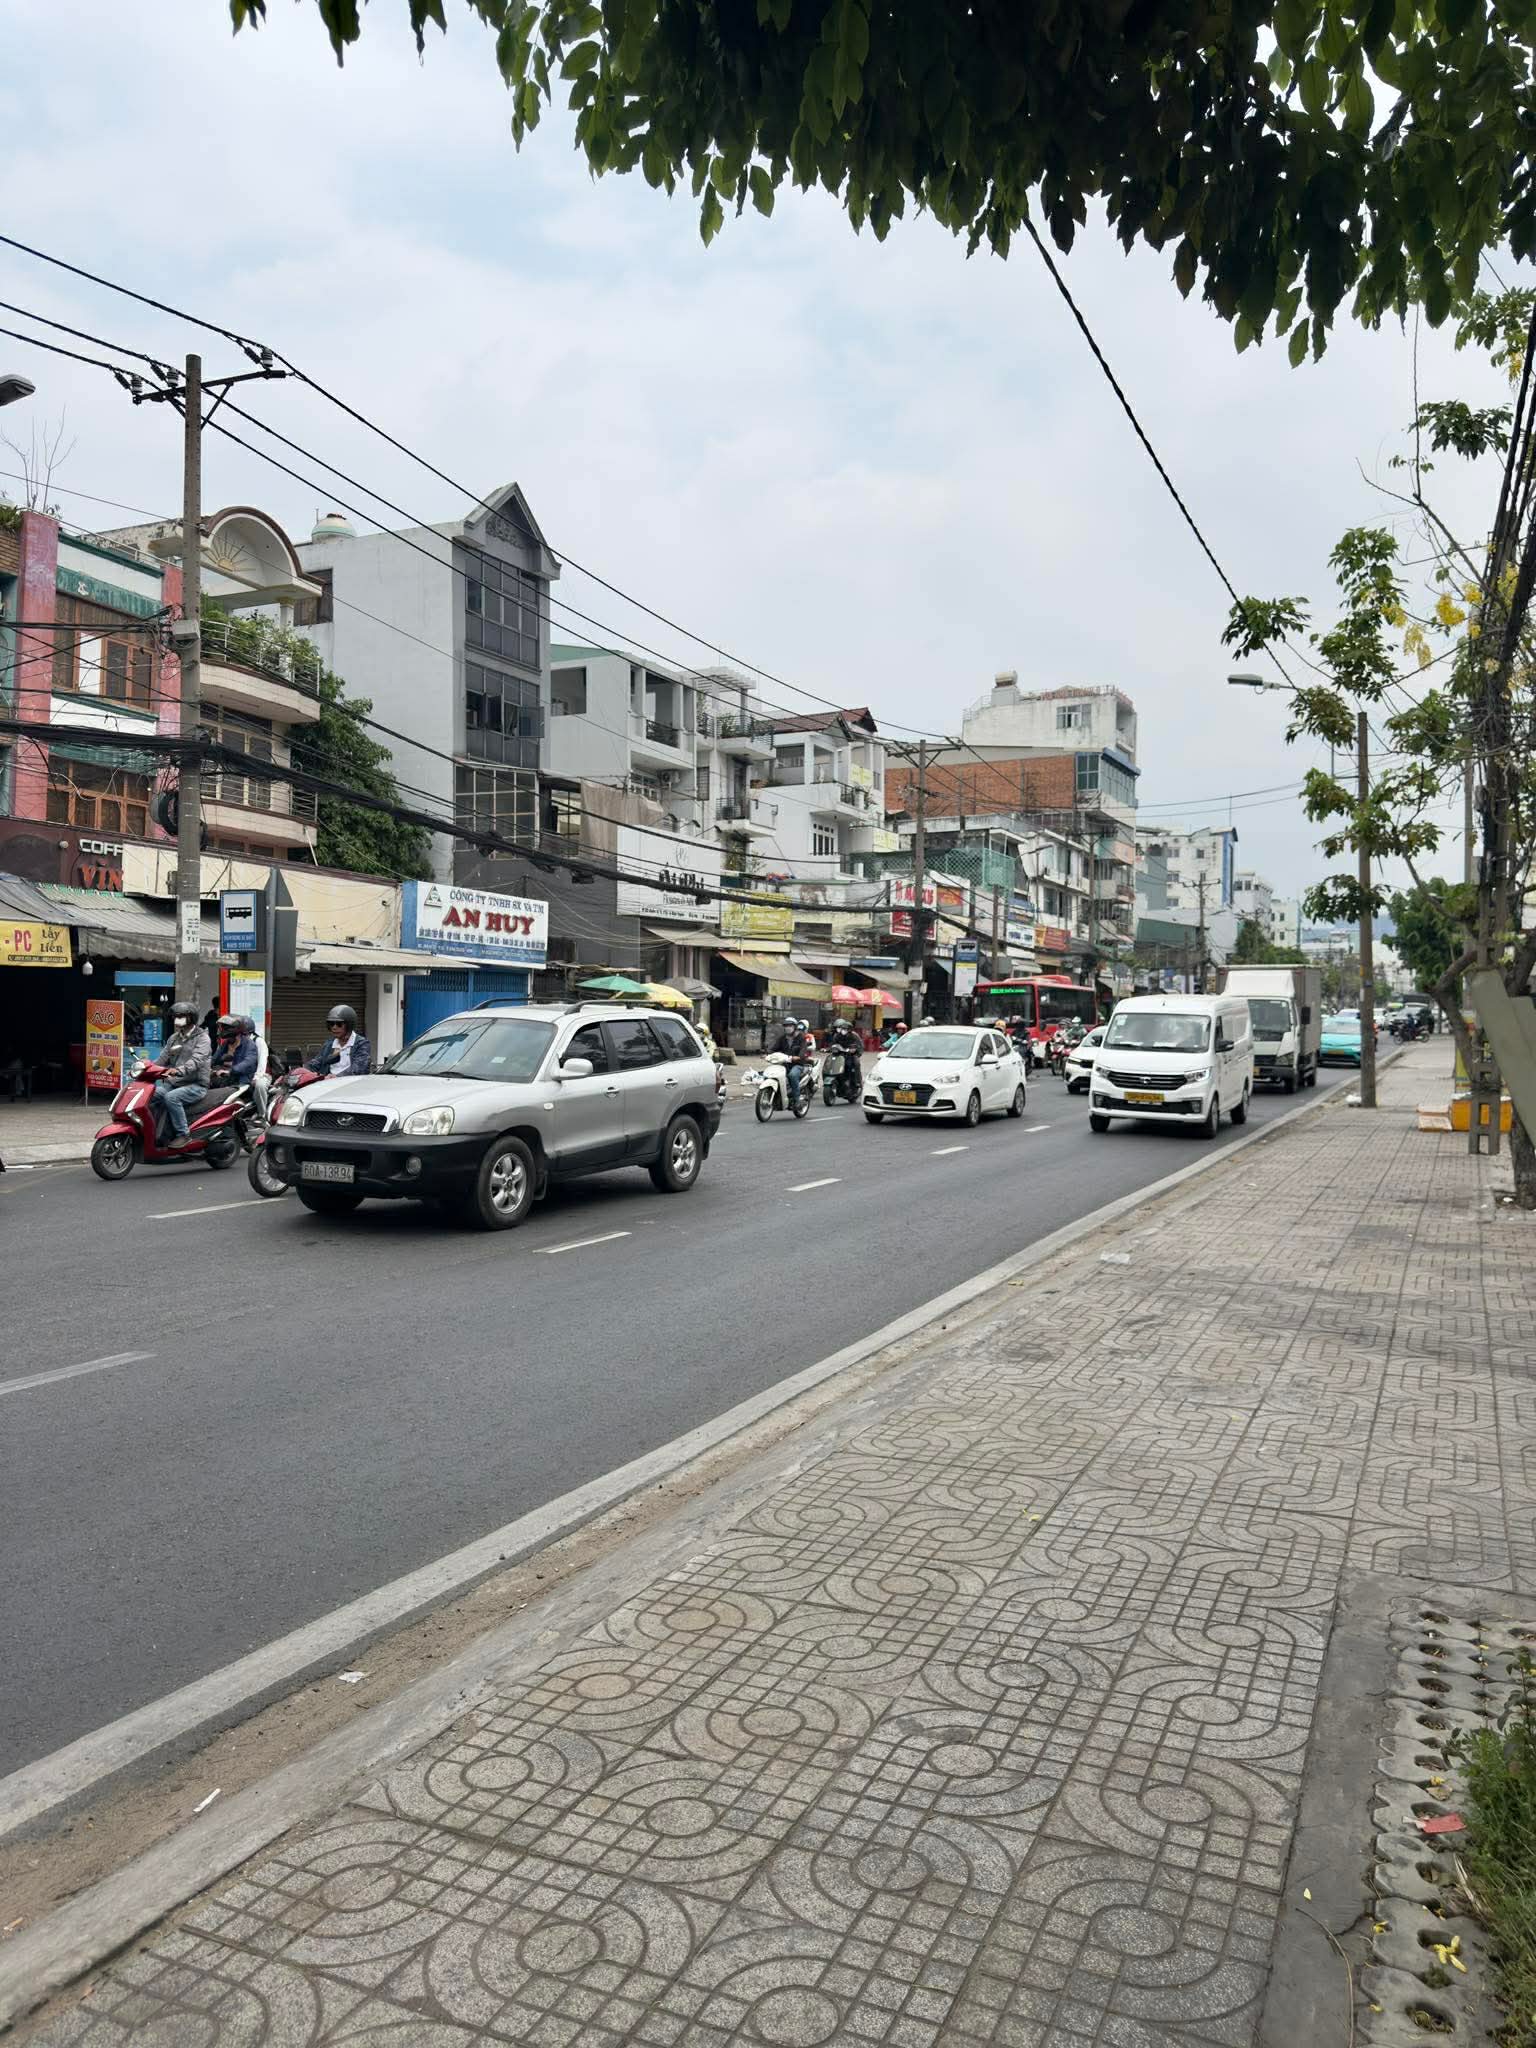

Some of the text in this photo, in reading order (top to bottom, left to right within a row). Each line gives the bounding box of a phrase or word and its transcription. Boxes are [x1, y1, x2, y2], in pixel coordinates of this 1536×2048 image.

[450, 890, 473, 902] CÔNG
[475, 894, 487, 905] TY
[488, 896, 511, 909] TNHH
[442, 905, 535, 935] AN HUY
[14, 929, 32, 952] PC
